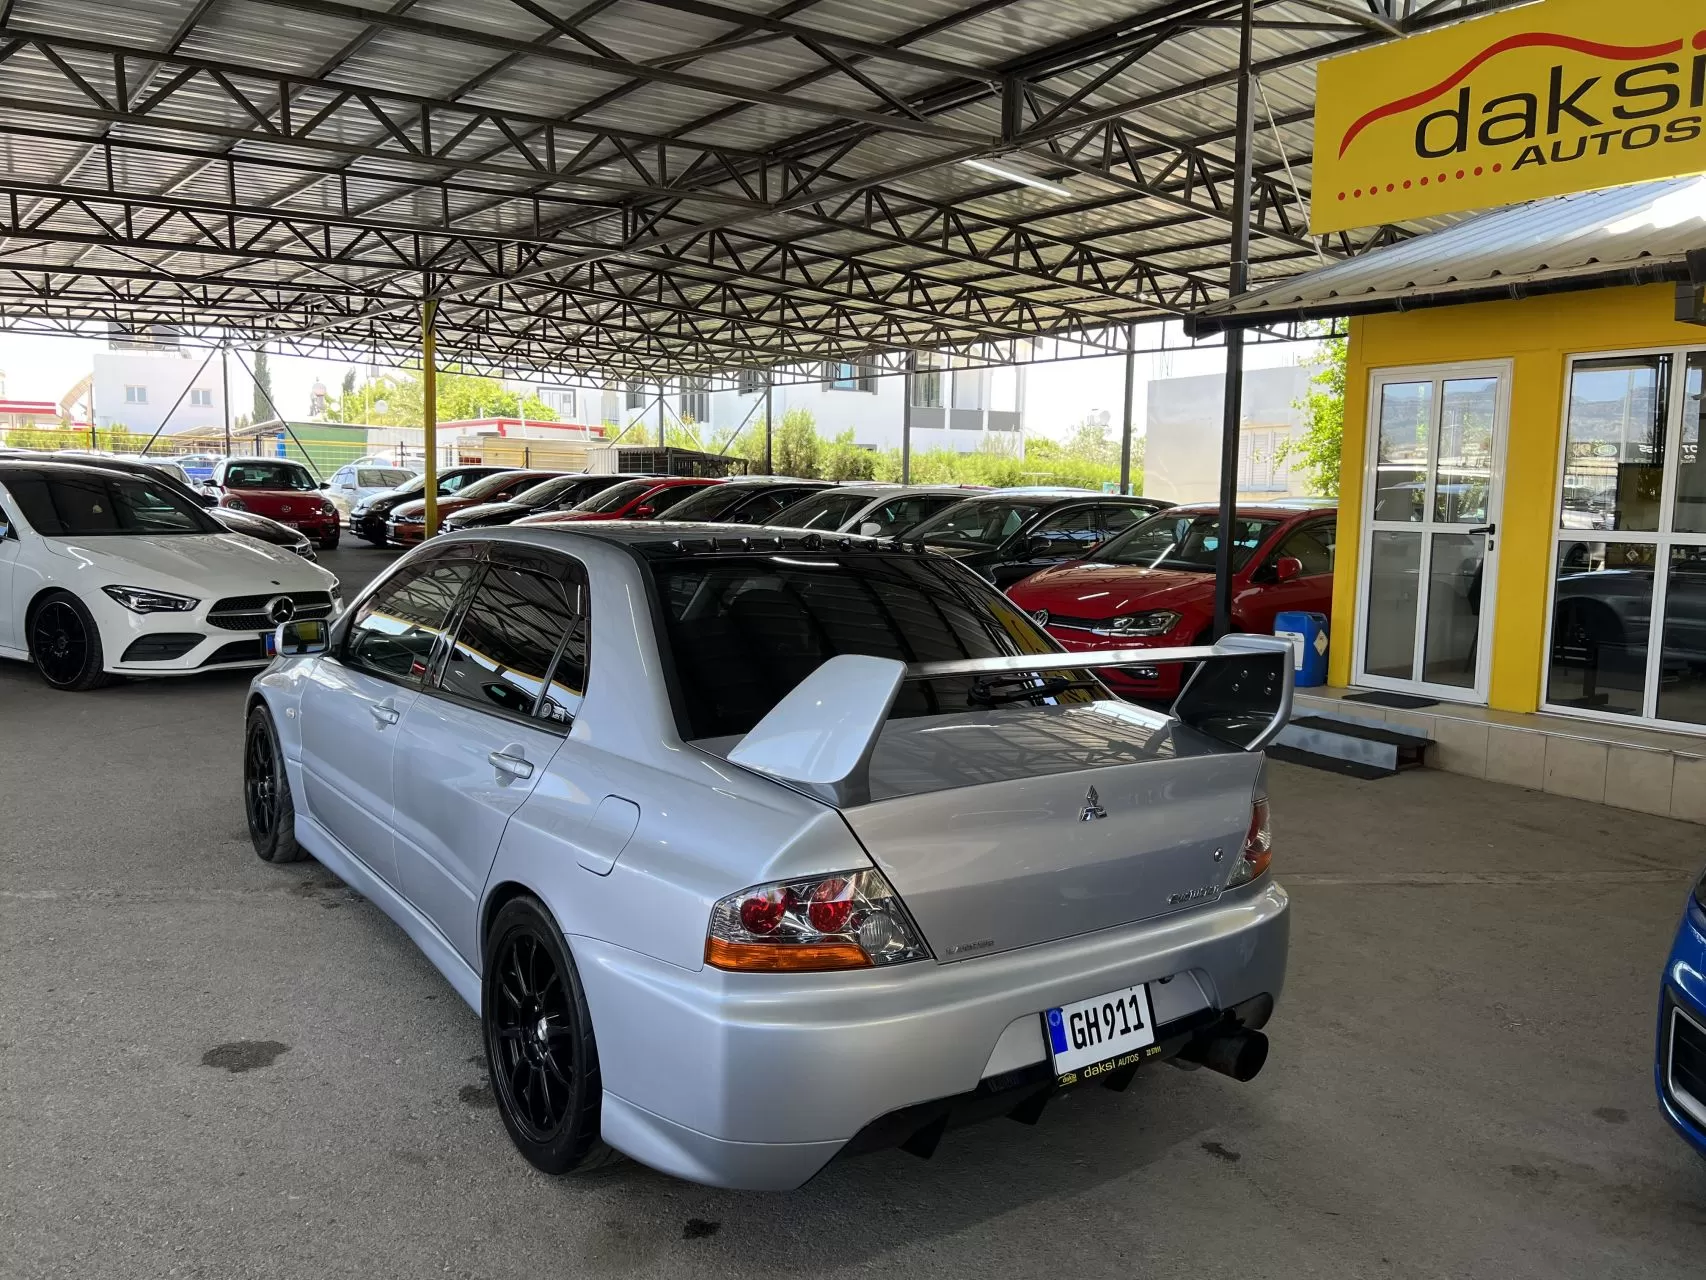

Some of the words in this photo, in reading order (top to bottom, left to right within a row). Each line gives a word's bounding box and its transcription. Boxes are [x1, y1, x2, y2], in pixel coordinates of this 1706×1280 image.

[1415, 30, 1706, 158] daksi
[1511, 116, 1702, 170] AUTOS
[1117, 1053, 1139, 1067] AUTOS
